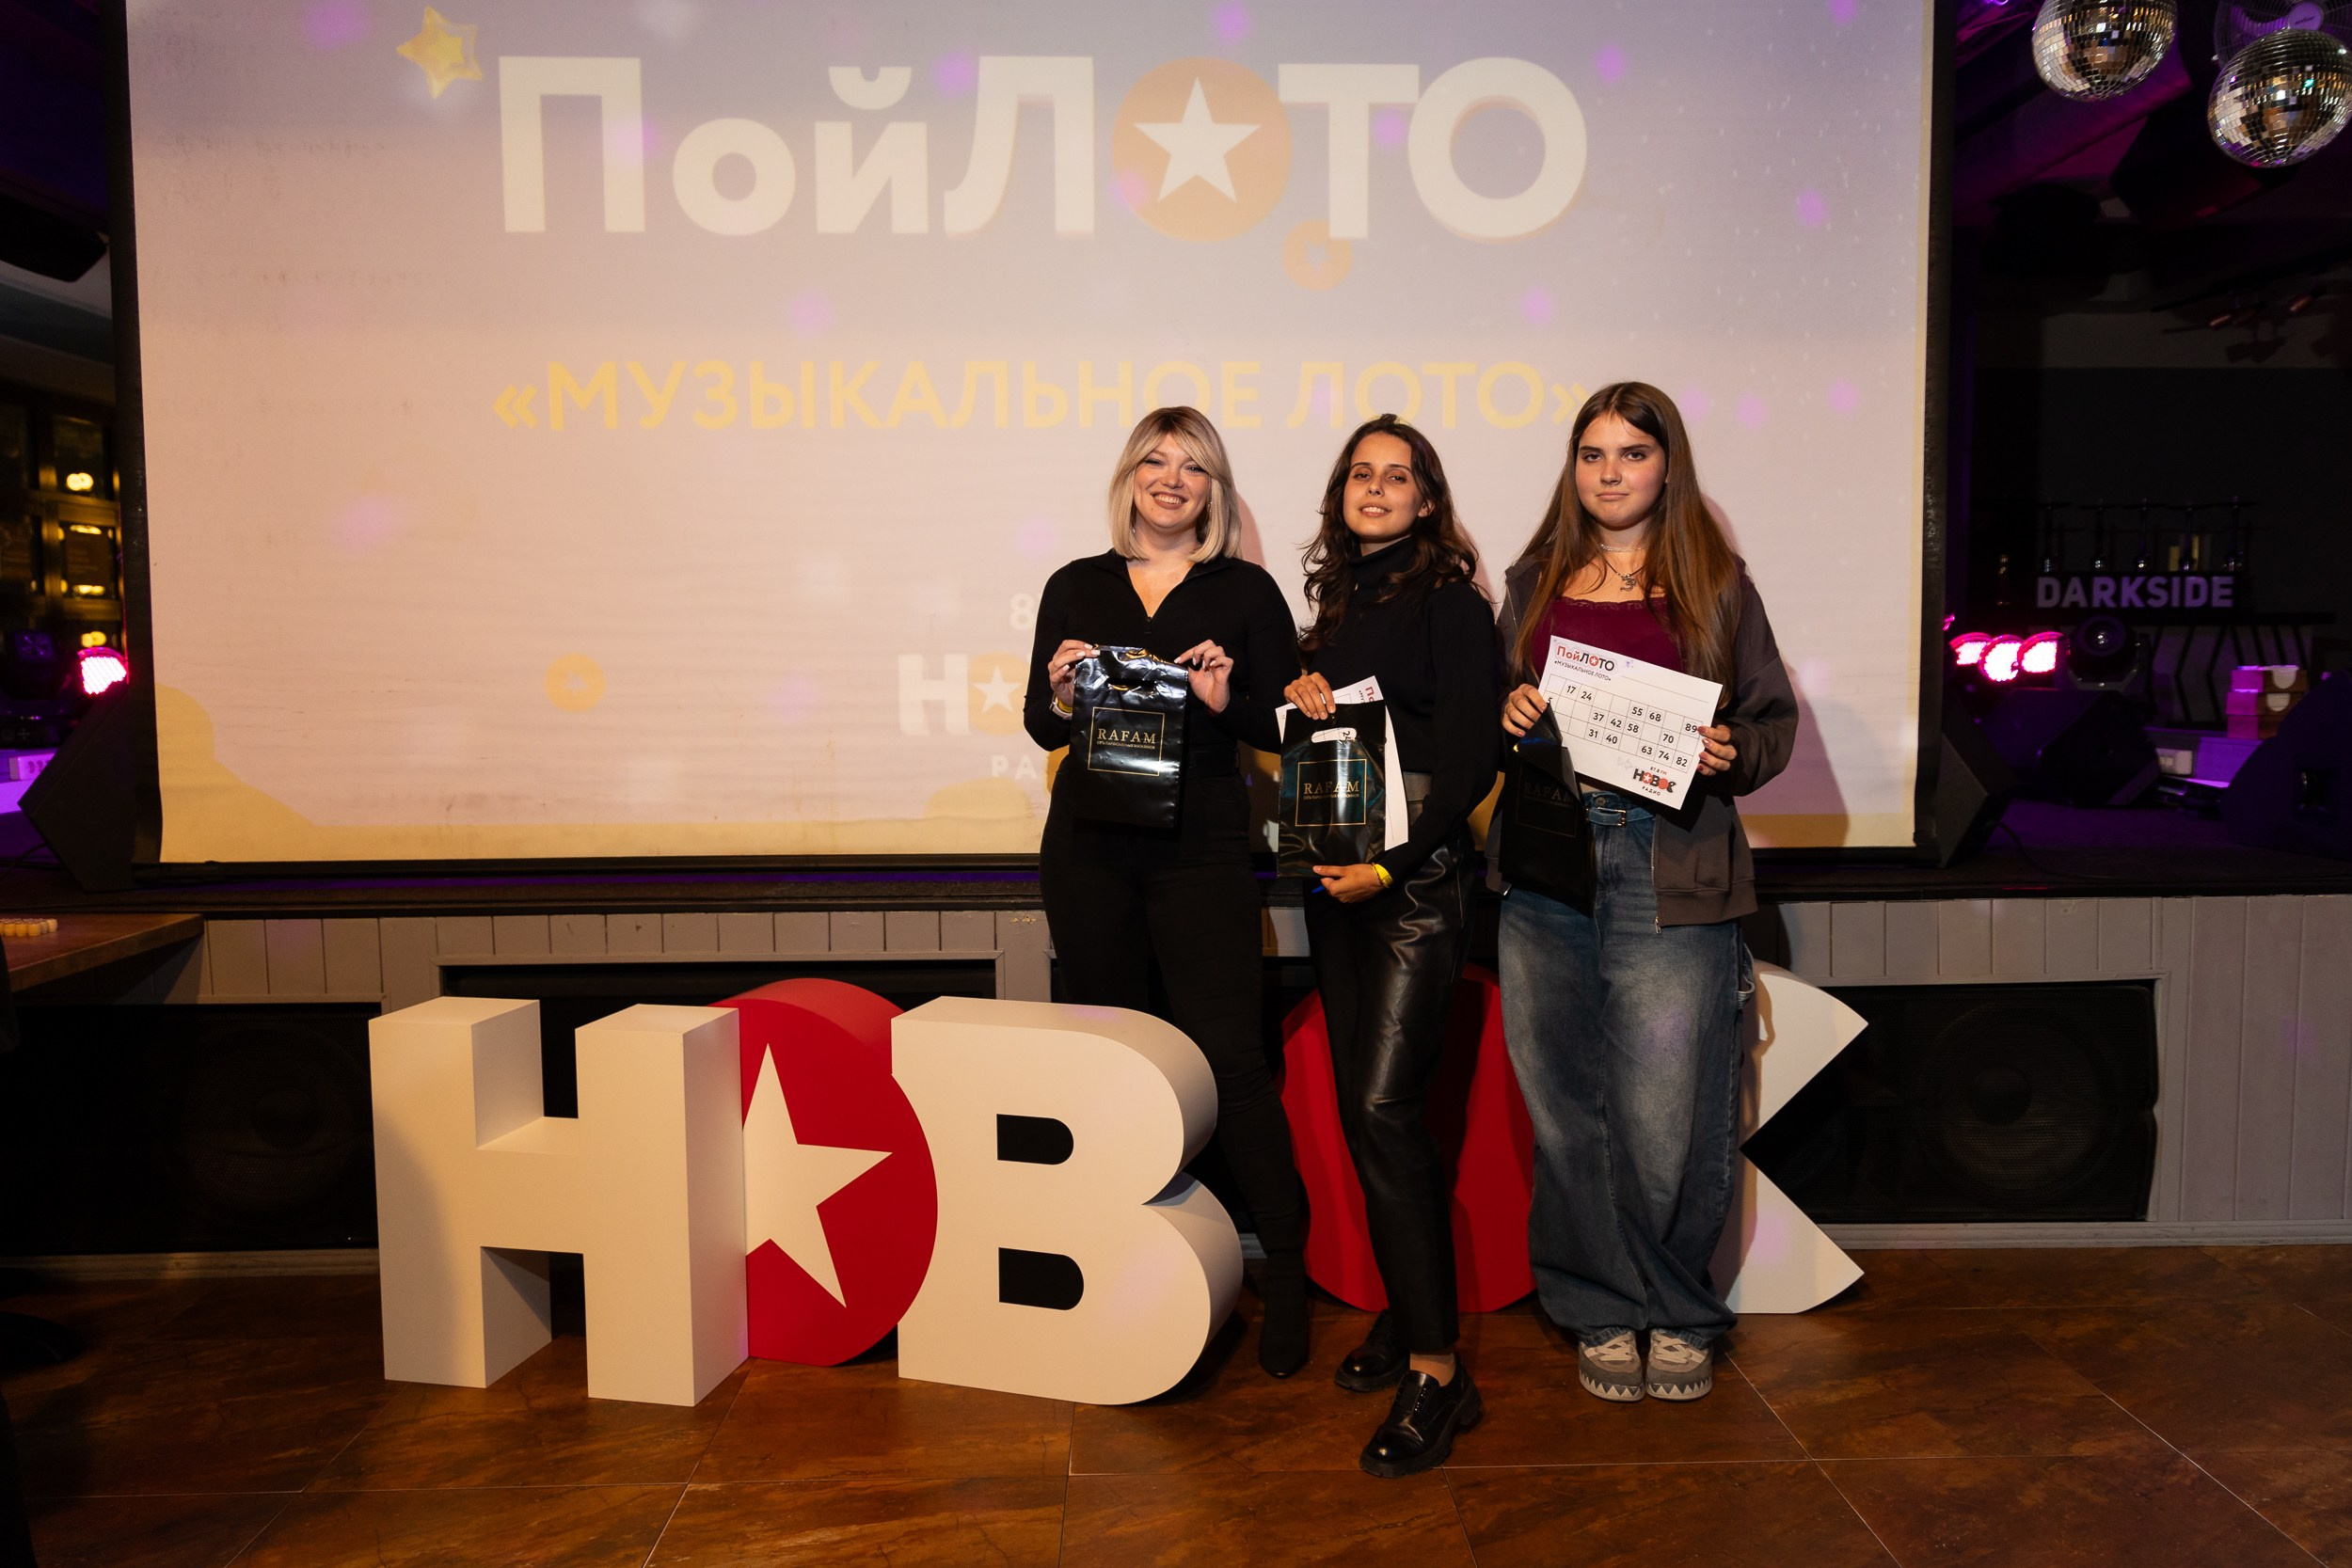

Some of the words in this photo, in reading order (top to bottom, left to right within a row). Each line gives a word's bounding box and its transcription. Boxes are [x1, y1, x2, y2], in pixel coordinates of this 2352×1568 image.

[499, 55, 1587, 243] ПойЛОТО
[492, 360, 1262, 431] «МУЗЫКАЛЬНОЕ
[2037, 576, 2234, 609] DARKSIDE
[1557, 645, 1614, 672] ПойЛОТО
[1566, 685, 1577, 694] 17
[1581, 690, 1592, 702] 24
[1631, 706, 1644, 717] 55
[1649, 712, 1661, 722] 68
[1685, 722, 1698, 734] 89
[1096, 728, 1157, 745] RAFAM
[1593, 712, 1605, 722] 37
[1610, 719, 1622, 728] 42
[1627, 722, 1640, 734] 58
[1662, 733, 1675, 744] 70
[1588, 729, 1598, 738] 31
[1606, 734, 1618, 744] 40
[1641, 745, 1653, 755] 63
[1658, 750, 1670, 761] 74
[1676, 756, 1688, 768] 82
